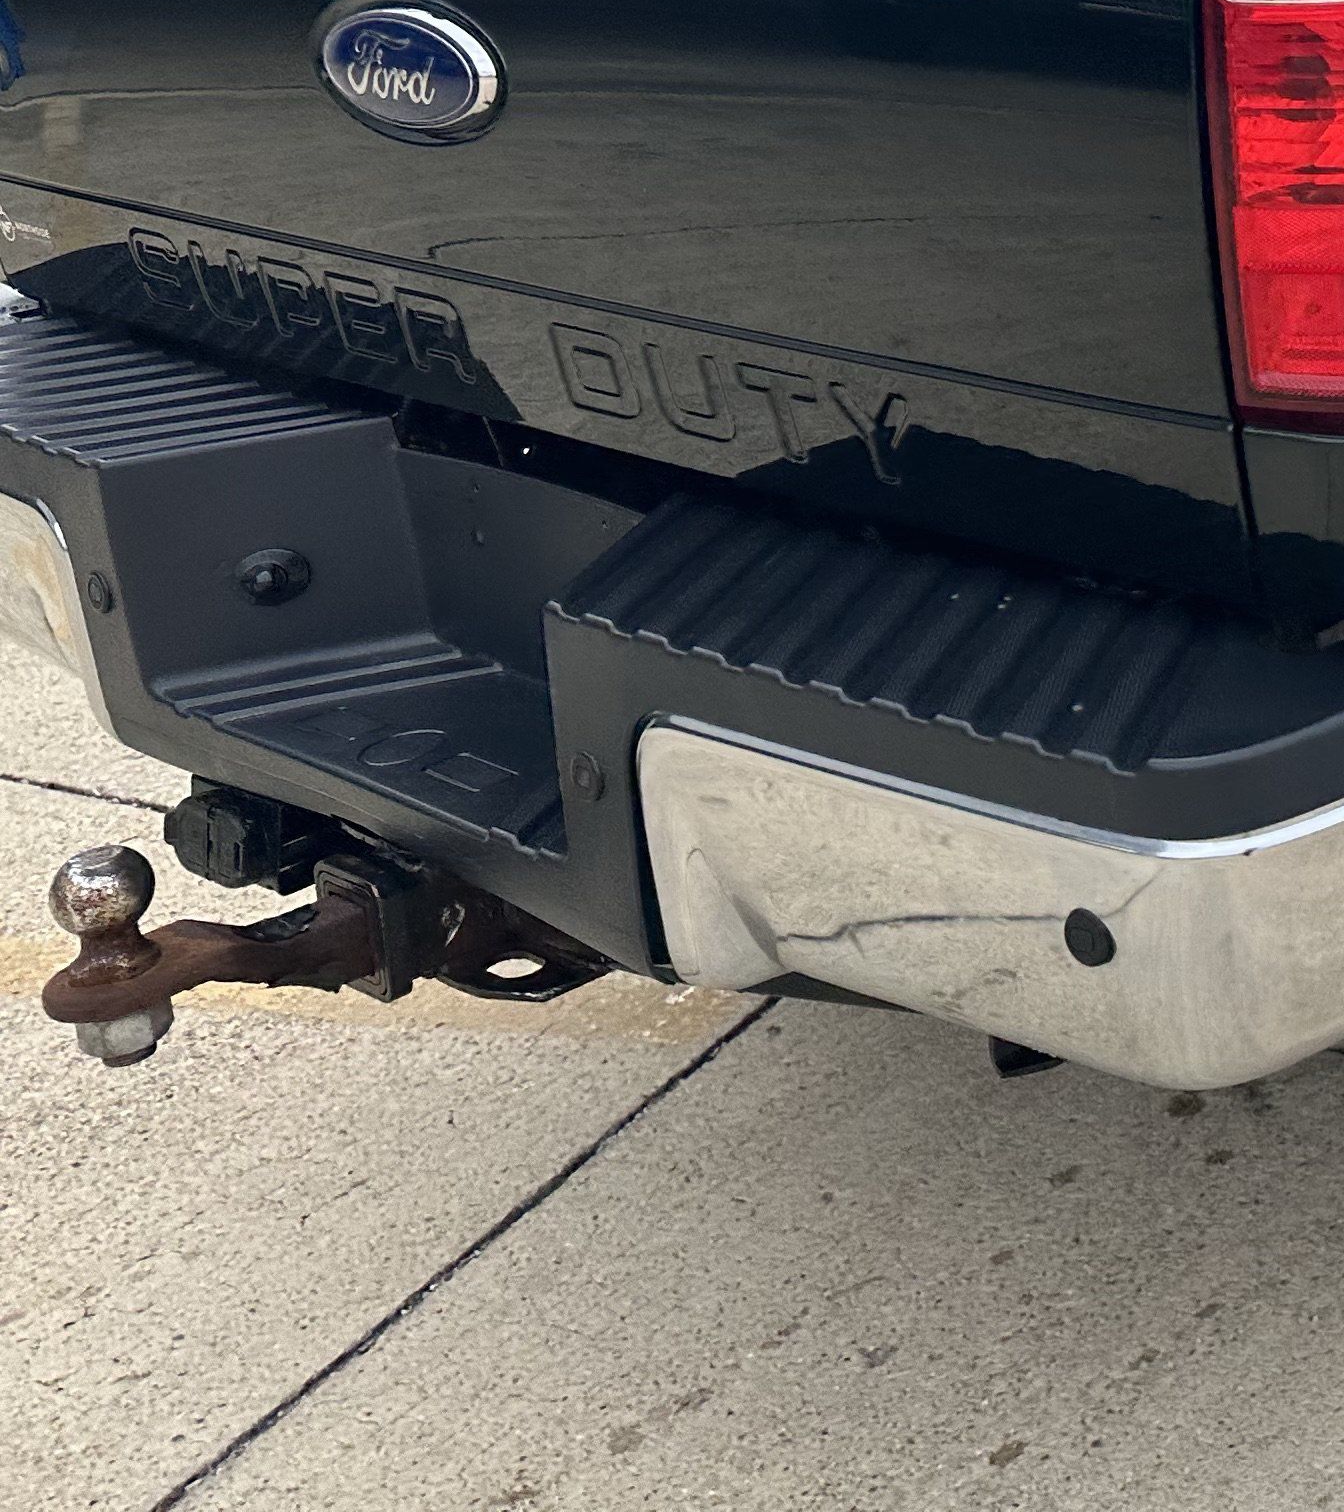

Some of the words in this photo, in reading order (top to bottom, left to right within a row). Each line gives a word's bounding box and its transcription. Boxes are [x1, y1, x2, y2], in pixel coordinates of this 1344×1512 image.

[347, 29, 436, 105] Ford
[128, 227, 476, 384] SUPER
[549, 321, 911, 486] DUTY
